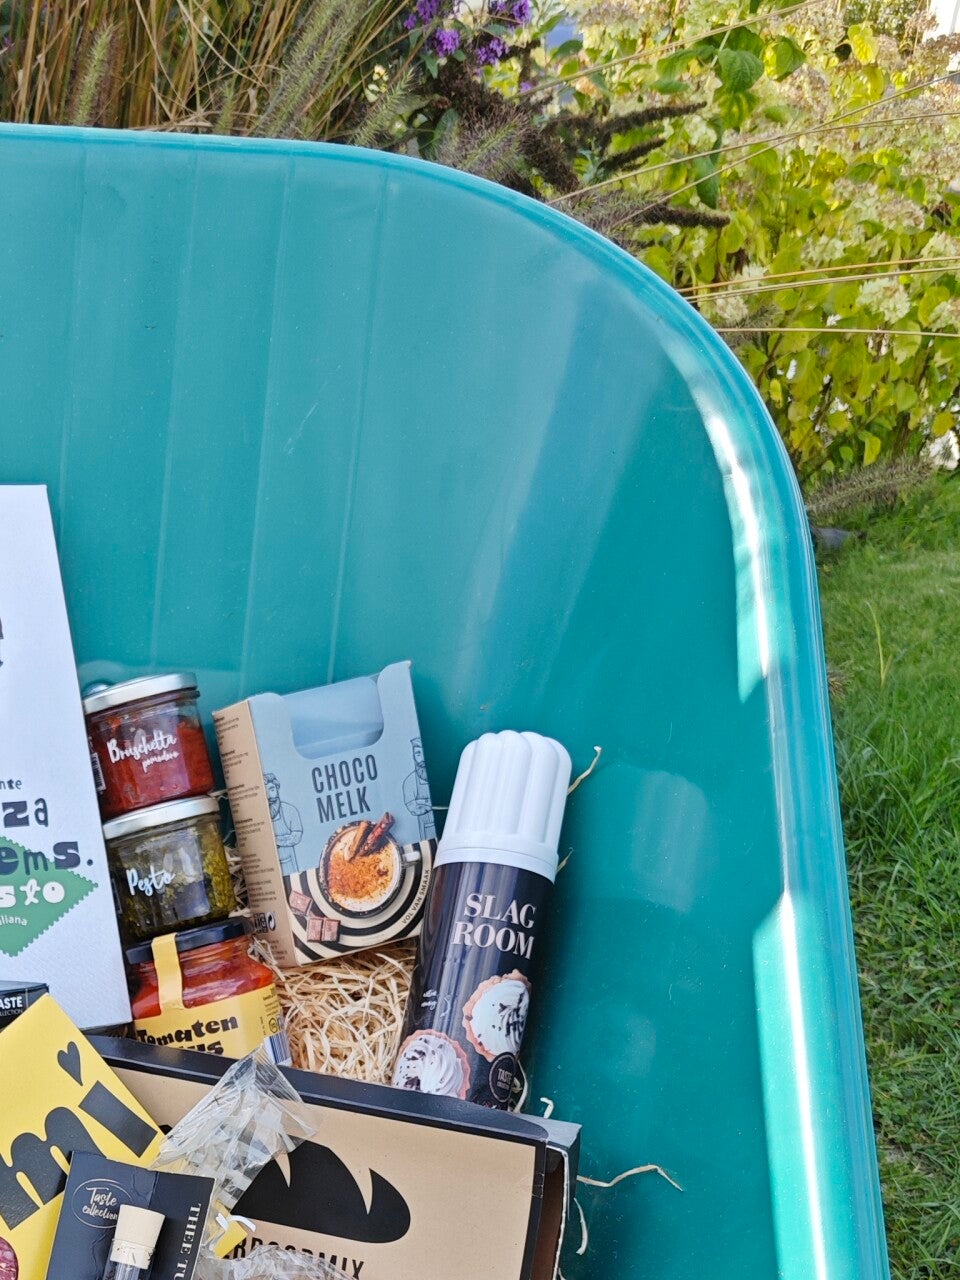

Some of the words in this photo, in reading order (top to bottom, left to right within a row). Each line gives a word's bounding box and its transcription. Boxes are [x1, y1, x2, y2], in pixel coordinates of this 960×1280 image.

[107, 728, 178, 763] Bruschetta
[312, 754, 379, 794] CHOCO
[316, 786, 371, 823] MELK
[126, 865, 176, 896] Pesto
[402, 910, 414, 925] VOL
[412, 896, 423, 912] VAN
[420, 869, 430, 896] SMAAK
[464, 893, 536, 929] SLAG
[451, 921, 535, 960] ROOM
[137, 1016, 238, 1046] Tomaten
[86, 1186, 117, 1206] Taste
[180, 1203, 201, 1254] THEE
